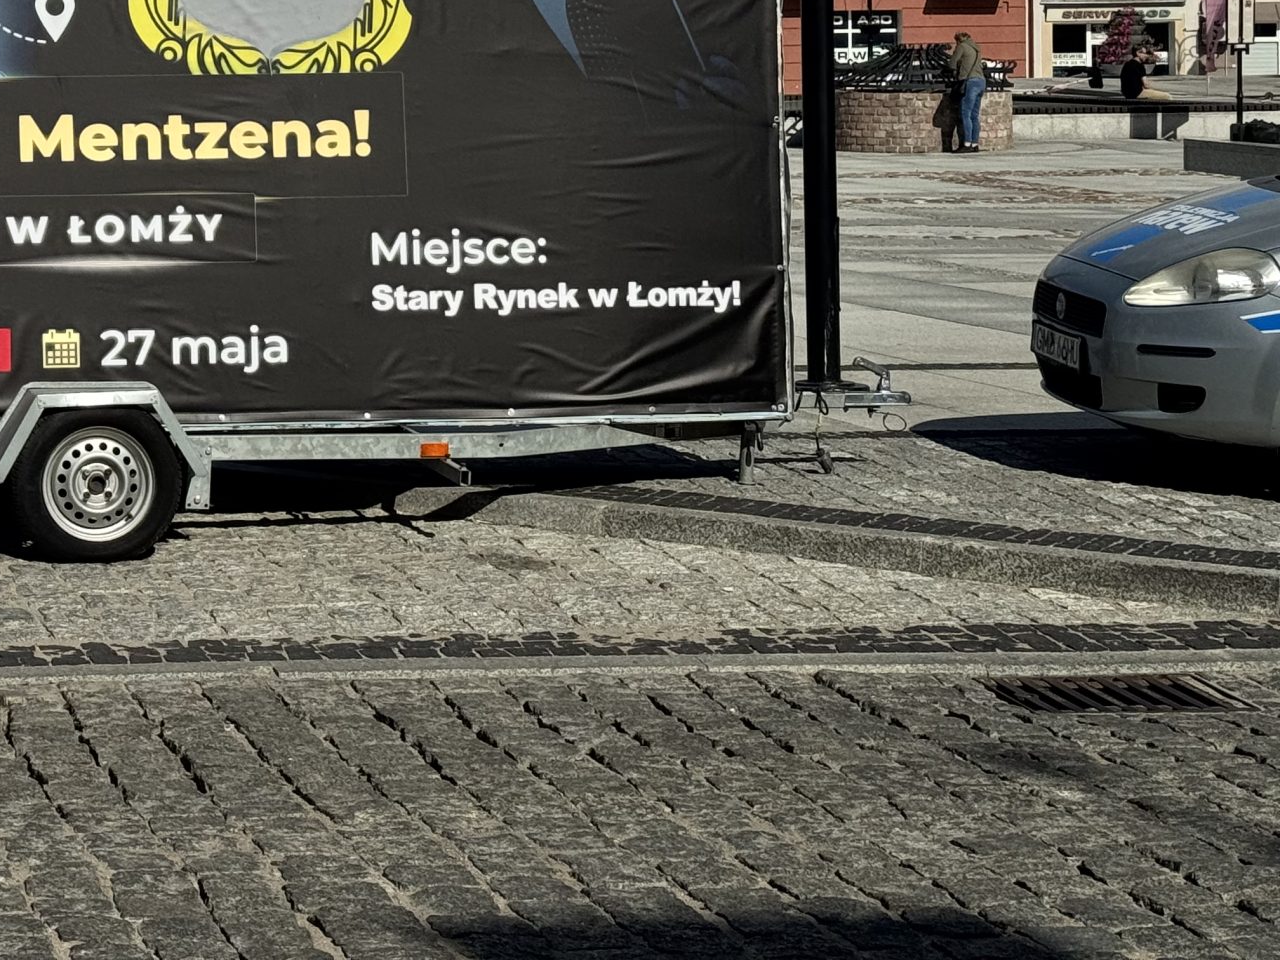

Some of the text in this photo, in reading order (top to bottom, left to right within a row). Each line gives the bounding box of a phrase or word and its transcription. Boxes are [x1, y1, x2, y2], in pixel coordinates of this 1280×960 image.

[1061, 10, 1111, 20] SERW
[18, 109, 373, 164] Mentzena!
[5, 215, 49, 245] W
[66, 205, 223, 244] ŁOMŻY
[371, 228, 548, 274] Miejsce:
[371, 280, 742, 317] Stary Rynek w Łomży!
[99, 324, 289, 374] 27 maja
